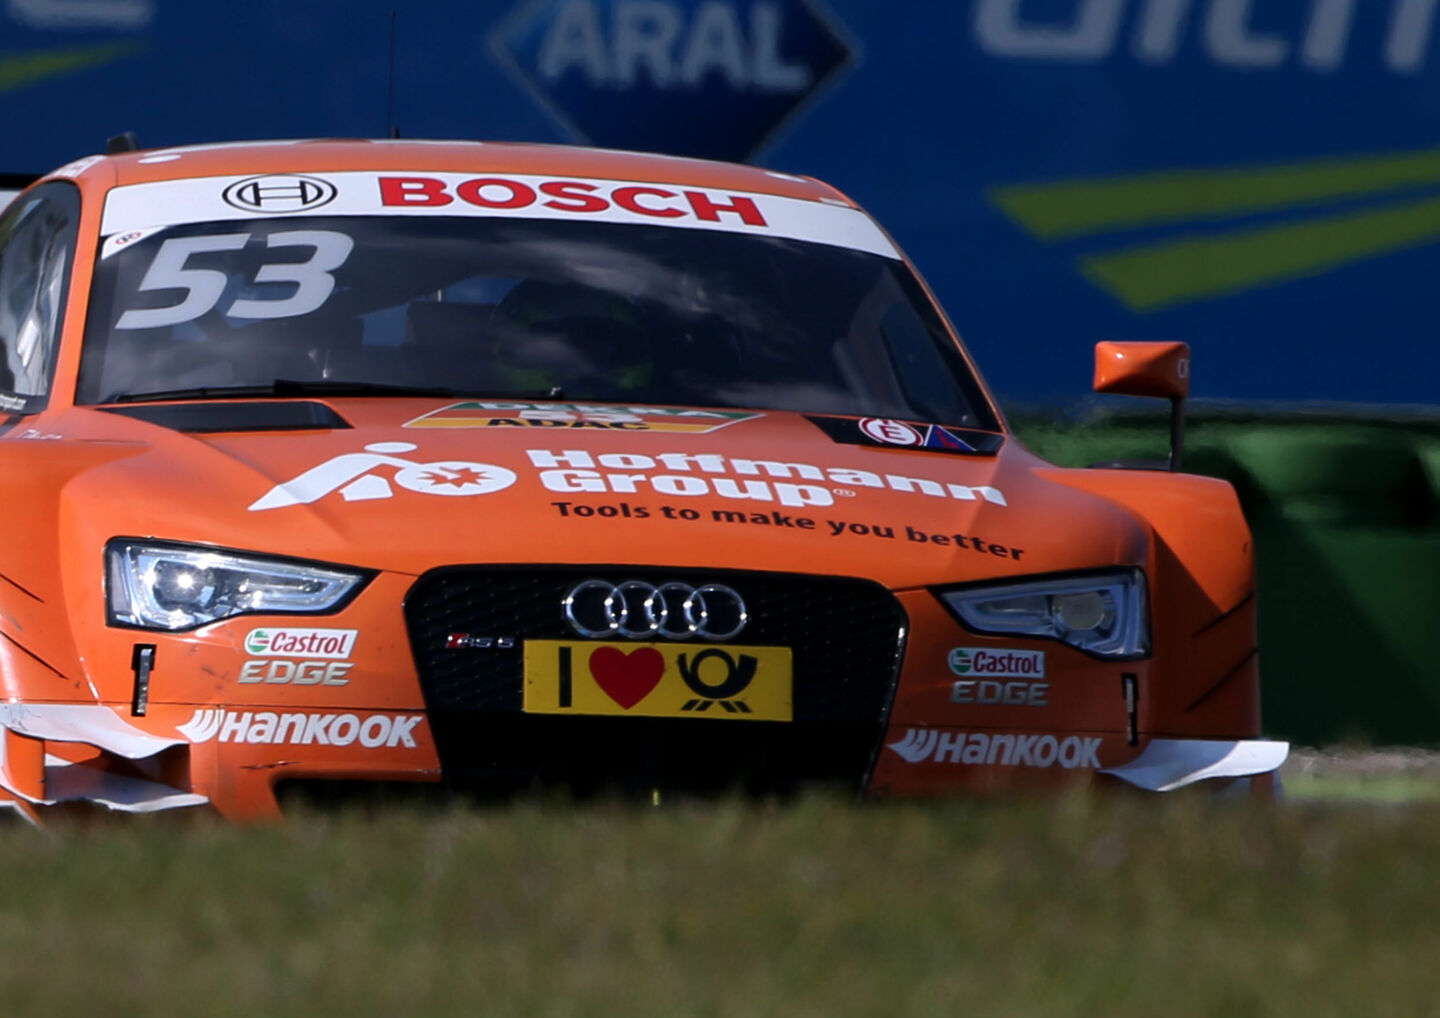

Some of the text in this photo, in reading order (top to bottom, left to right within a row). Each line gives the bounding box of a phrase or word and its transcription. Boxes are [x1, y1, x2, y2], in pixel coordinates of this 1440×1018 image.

[538, 0, 808, 88] ARAL
[378, 177, 769, 227] BOSCH
[114, 231, 354, 330] 53
[487, 418, 651, 430] ADAC
[526, 449, 1008, 507] Hoffmann
[551, 502, 1025, 561] Tools to make you better
[269, 630, 348, 656] Castrol
[238, 660, 355, 687] EDGE
[972, 650, 1042, 675] Castrol
[951, 681, 1051, 707] EDGE
